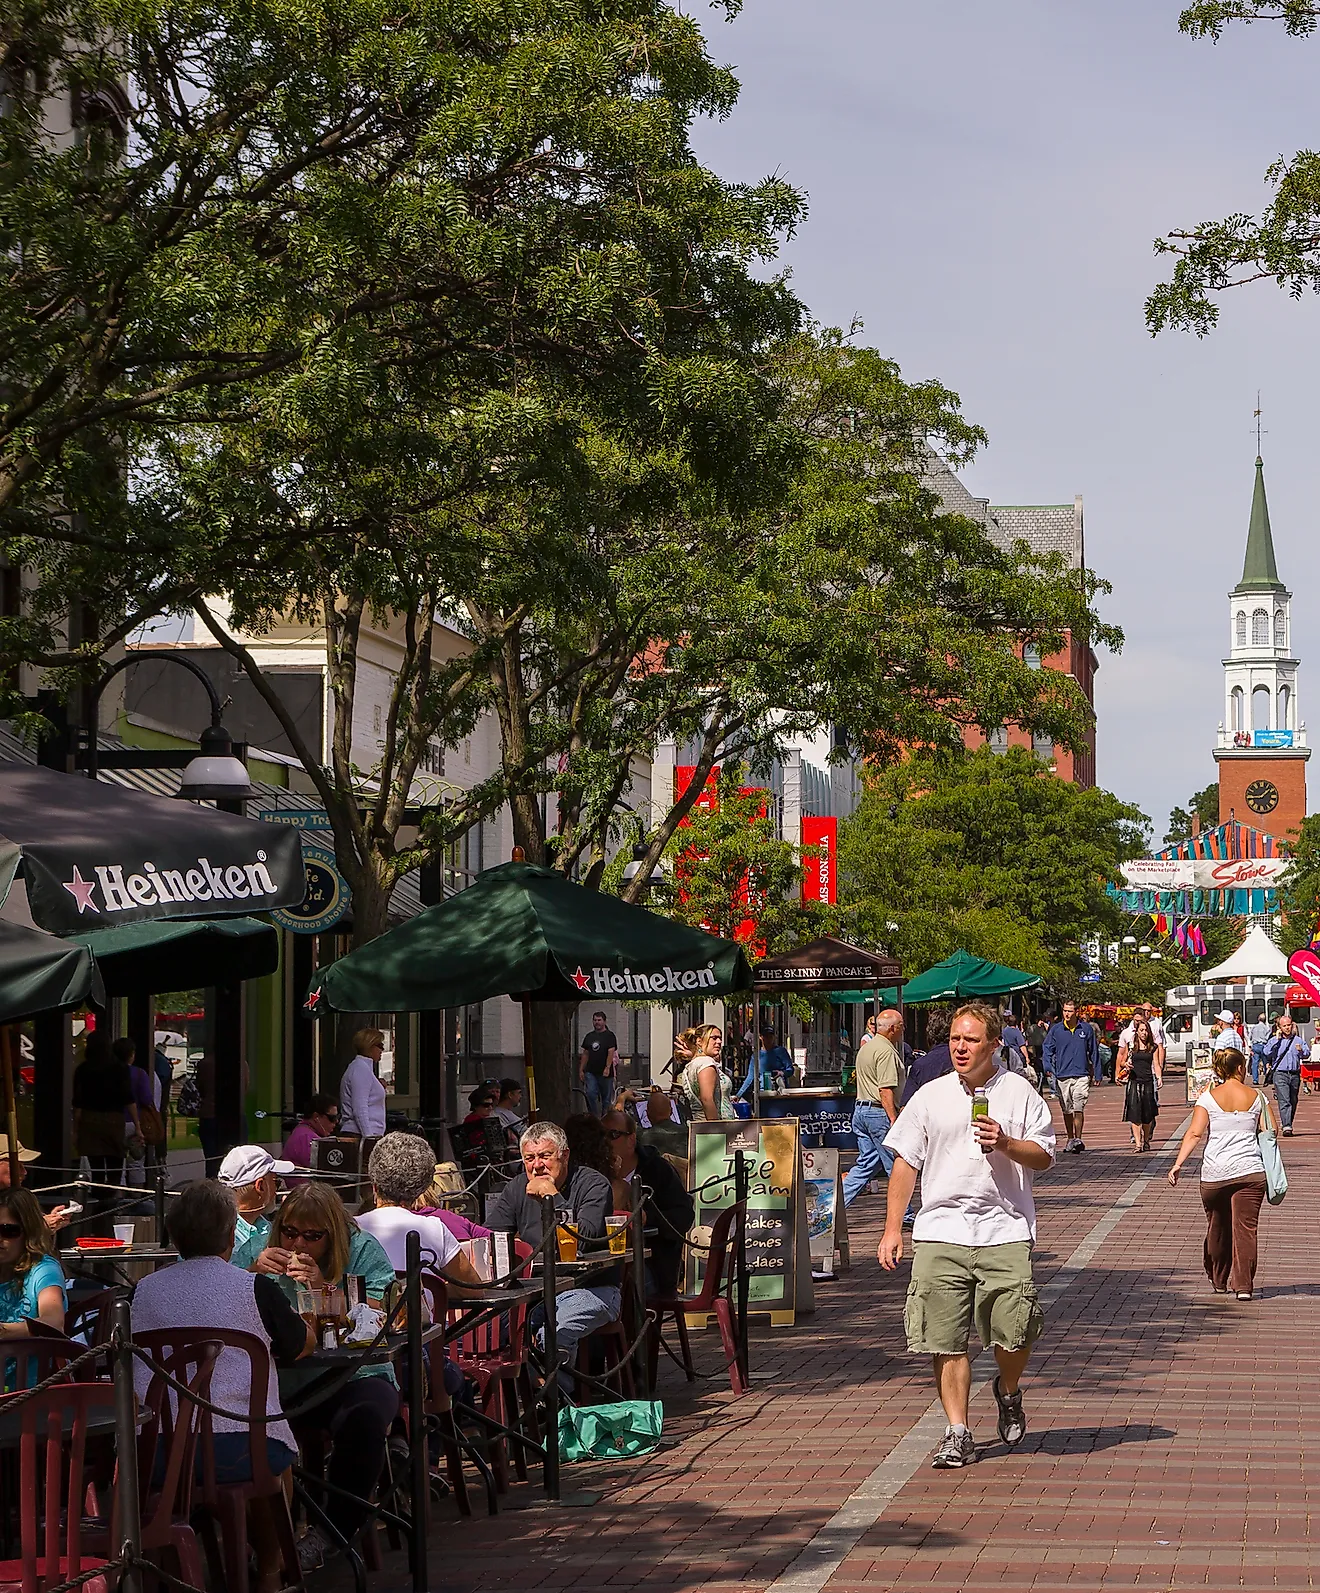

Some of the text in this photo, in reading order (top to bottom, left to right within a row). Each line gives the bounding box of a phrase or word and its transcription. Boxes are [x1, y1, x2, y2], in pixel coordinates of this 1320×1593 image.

[264, 814, 307, 827] Happy
[94, 858, 278, 912] Heineken
[1212, 860, 1277, 889] Stowe
[593, 966, 716, 994] Heineken
[759, 969, 782, 979] THE
[783, 967, 823, 978] SKINNY
[825, 966, 872, 977] PANCAKE
[820, 1110, 852, 1120] Savory
[723, 1158, 775, 1180] Ice
[699, 1174, 790, 1205] Cram
[745, 1237, 783, 1249] Cones
